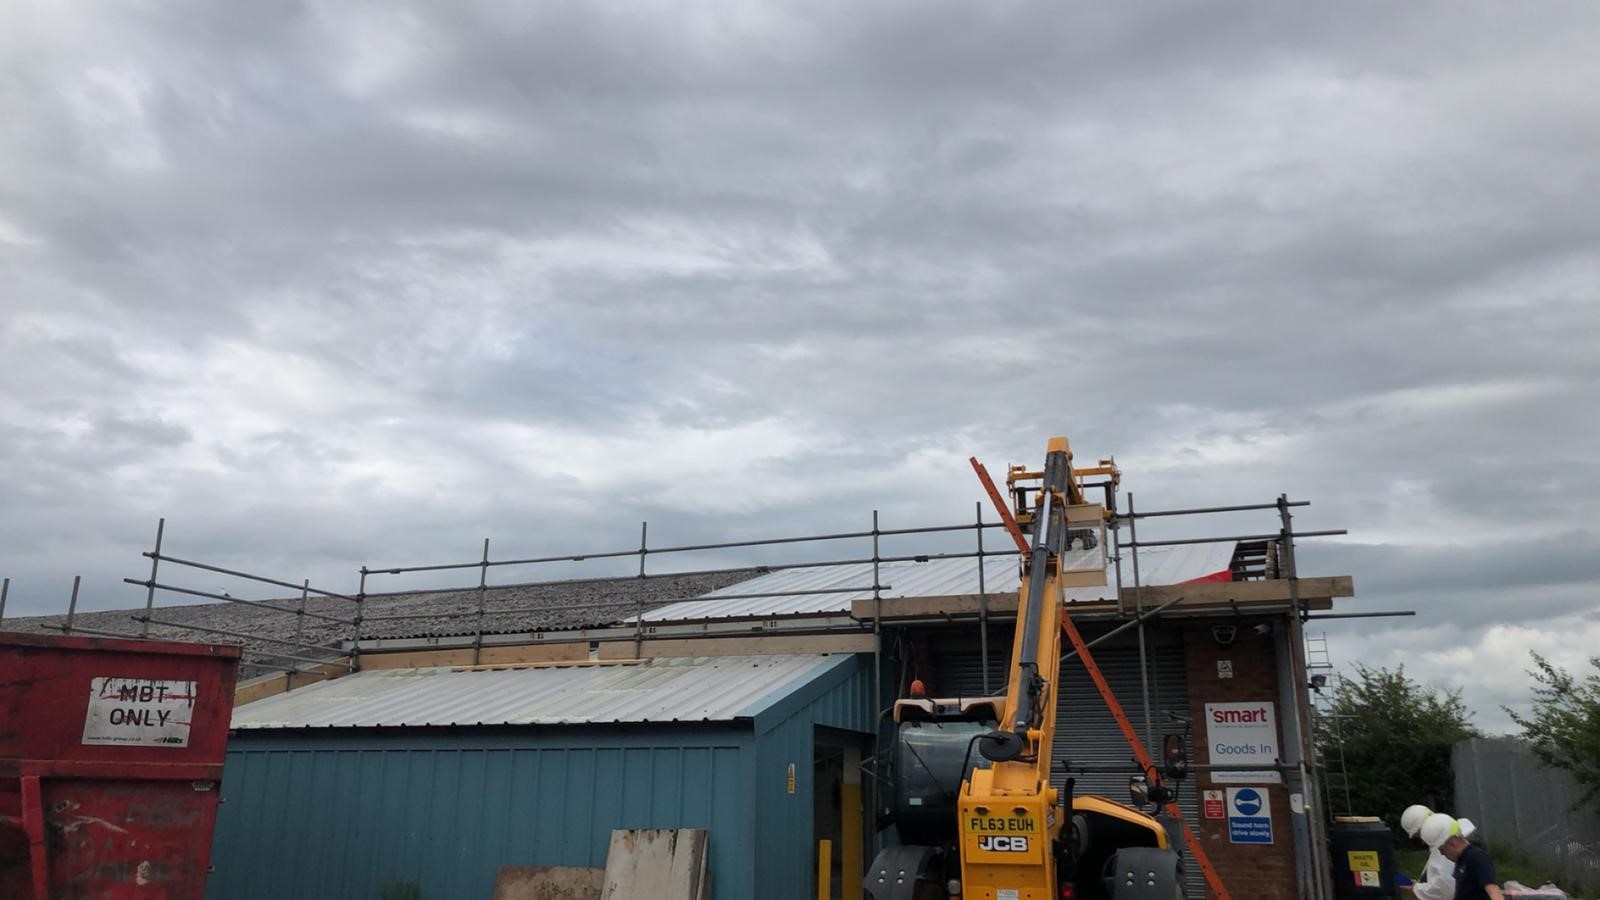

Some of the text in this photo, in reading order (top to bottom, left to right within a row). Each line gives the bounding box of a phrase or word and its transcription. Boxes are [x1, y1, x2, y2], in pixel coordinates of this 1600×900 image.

[120, 684, 169, 703] MBT
[110, 708, 171, 727] ONLY
[1213, 708, 1267, 723] smart
[1216, 743, 1271, 754] Goods In
[971, 818, 1005, 831] FL63
[1008, 819, 1034, 831] EUH
[979, 836, 1028, 851] JCB
